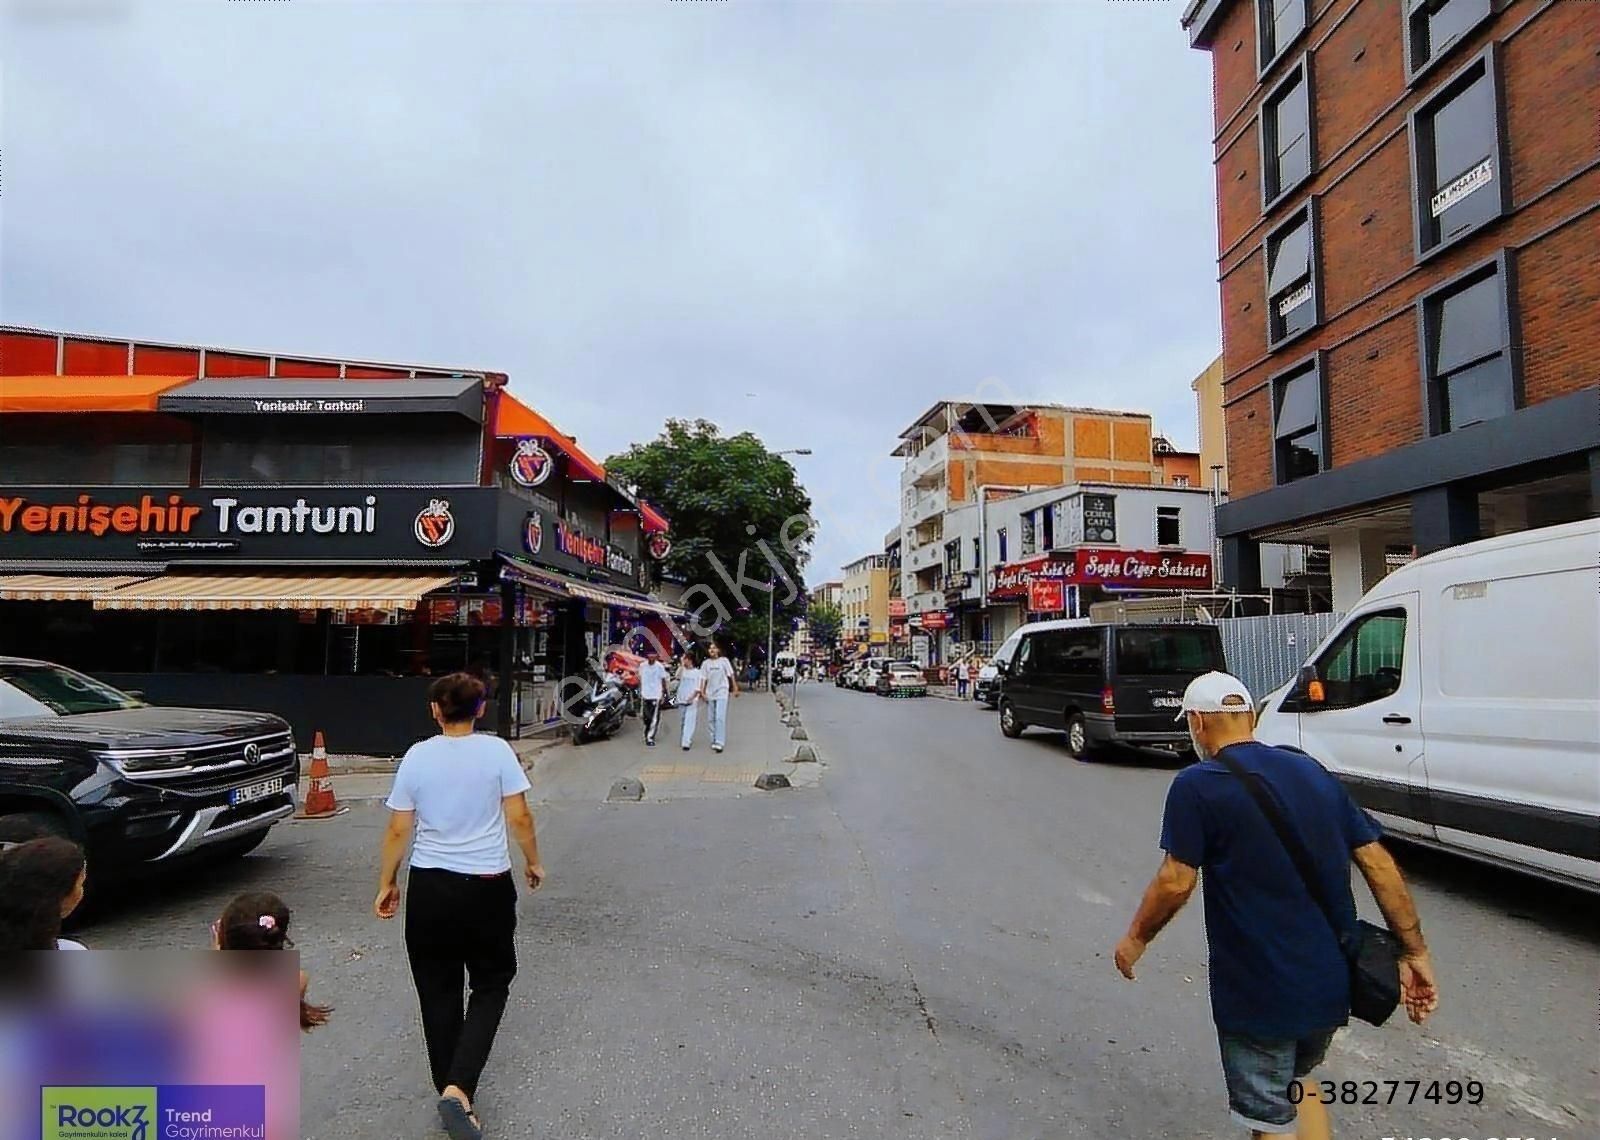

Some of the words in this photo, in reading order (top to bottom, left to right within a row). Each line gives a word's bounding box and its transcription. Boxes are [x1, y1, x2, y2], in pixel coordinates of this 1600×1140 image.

[255, 399, 312, 412] Yenişehir
[317, 399, 363, 411] Tantuni
[0, 495, 200, 536] Yenişehir
[212, 495, 376, 532] Tantuni
